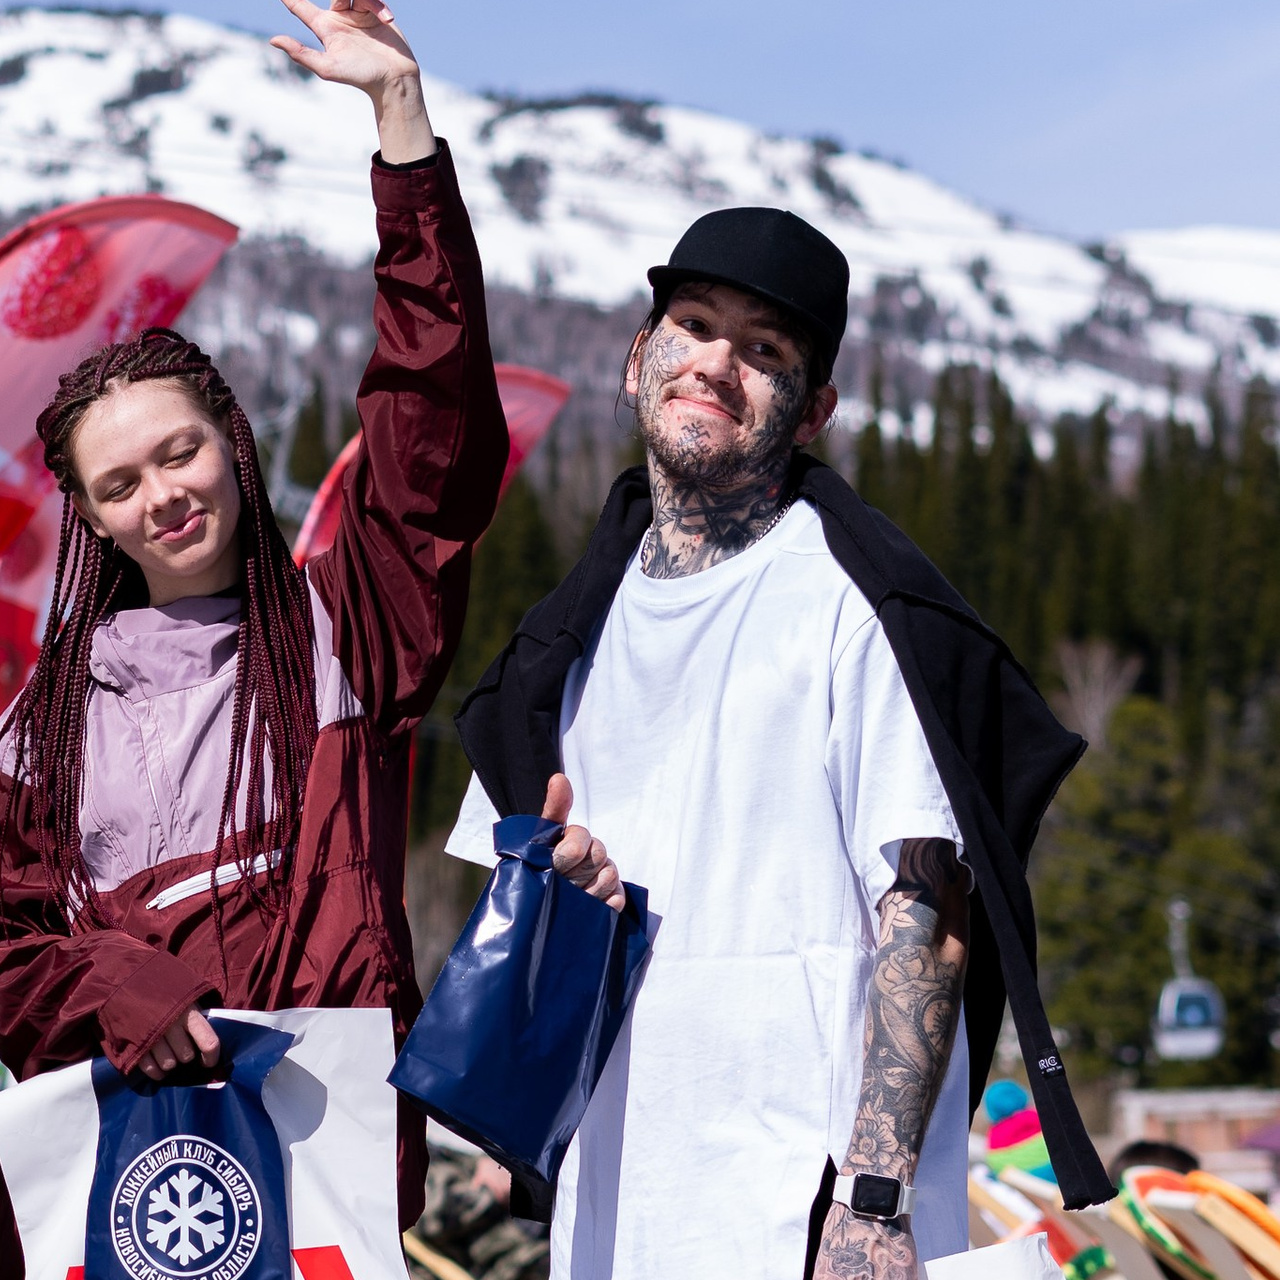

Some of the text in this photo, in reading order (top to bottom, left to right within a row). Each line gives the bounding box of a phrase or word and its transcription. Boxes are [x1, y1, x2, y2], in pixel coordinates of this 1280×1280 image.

[118, 1140, 254, 1212] ХОККЕЙНЫЙ КЛУБ СИБИРЬ
